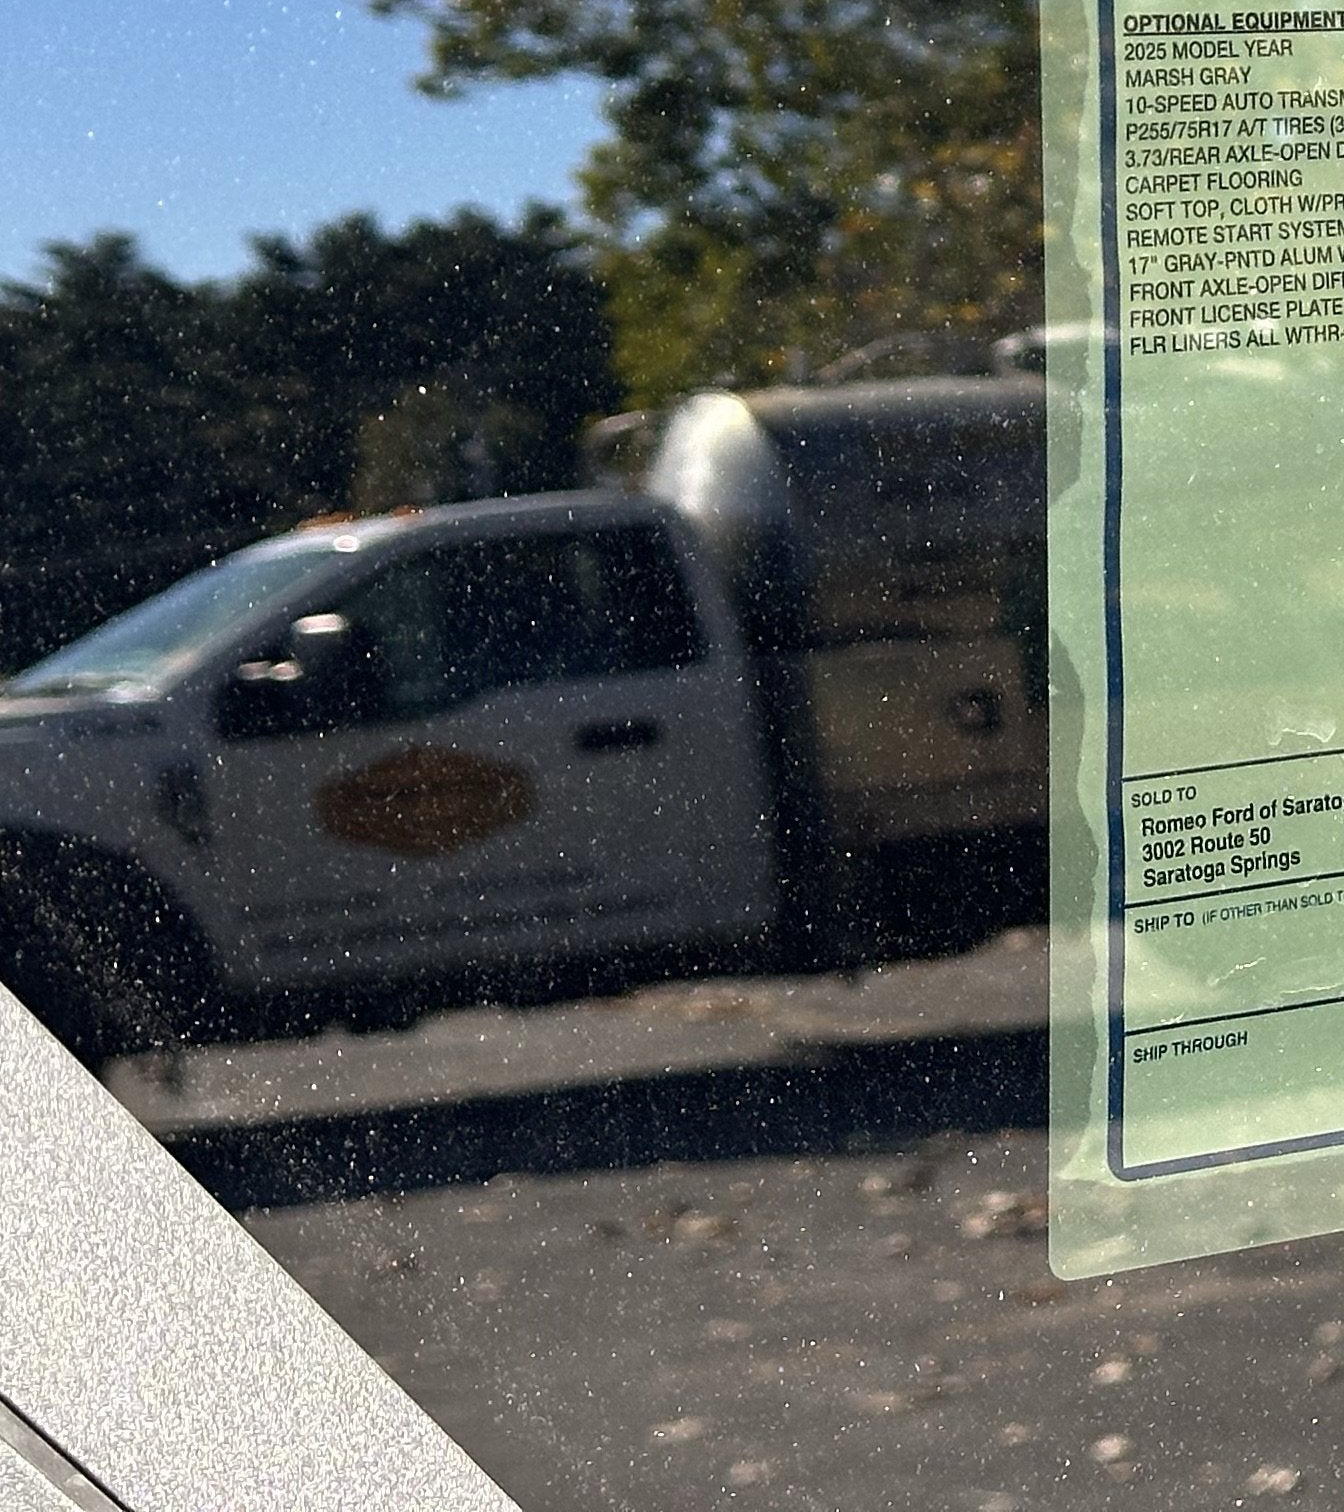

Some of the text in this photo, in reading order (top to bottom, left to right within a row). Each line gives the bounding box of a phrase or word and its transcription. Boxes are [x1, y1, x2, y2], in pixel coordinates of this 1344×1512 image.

[1122, 14, 1226, 32] OPTIONAL
[1125, 66, 1251, 86] MARSH GRAY
[1140, 809, 1207, 836] Romeo
[1211, 804, 1254, 828] Ford
[1258, 801, 1277, 822] of
[1141, 827, 1271, 861] 3002 Route 50
[1142, 858, 1225, 887] Saratoga
[1230, 848, 1301, 876] Springs
